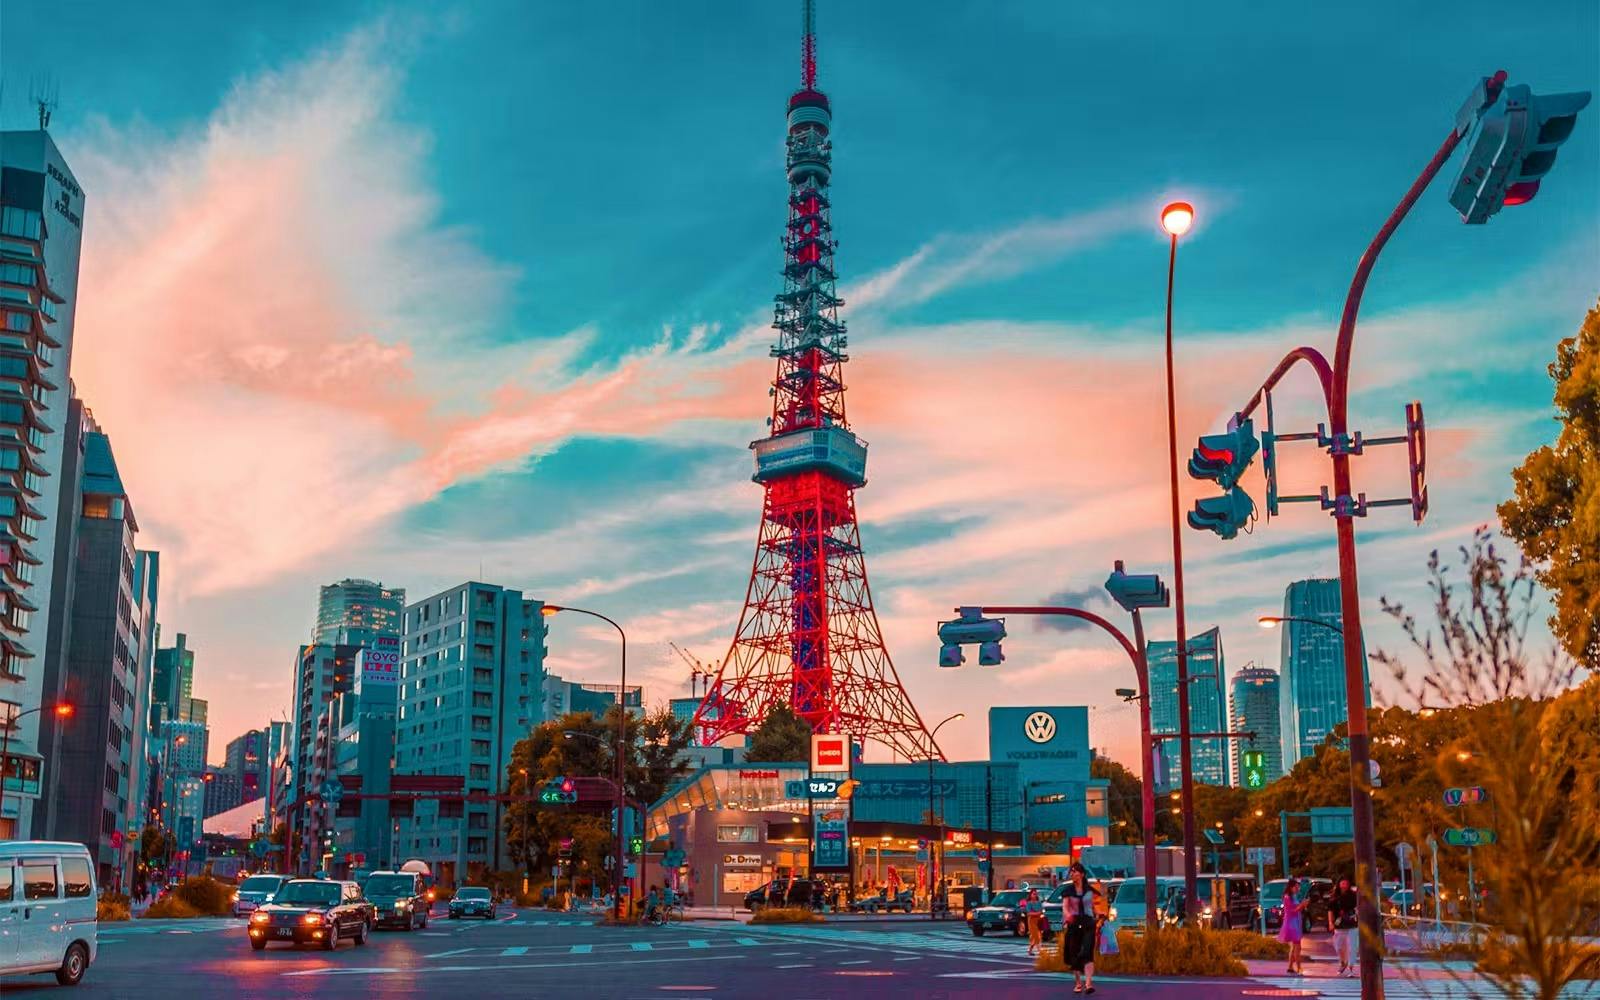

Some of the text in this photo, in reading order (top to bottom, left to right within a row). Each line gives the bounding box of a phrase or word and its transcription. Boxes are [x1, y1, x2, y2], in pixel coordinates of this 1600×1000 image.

[1006, 751, 1078, 759] VOLKSWAGEN
[810, 782, 836, 793] セルフ
